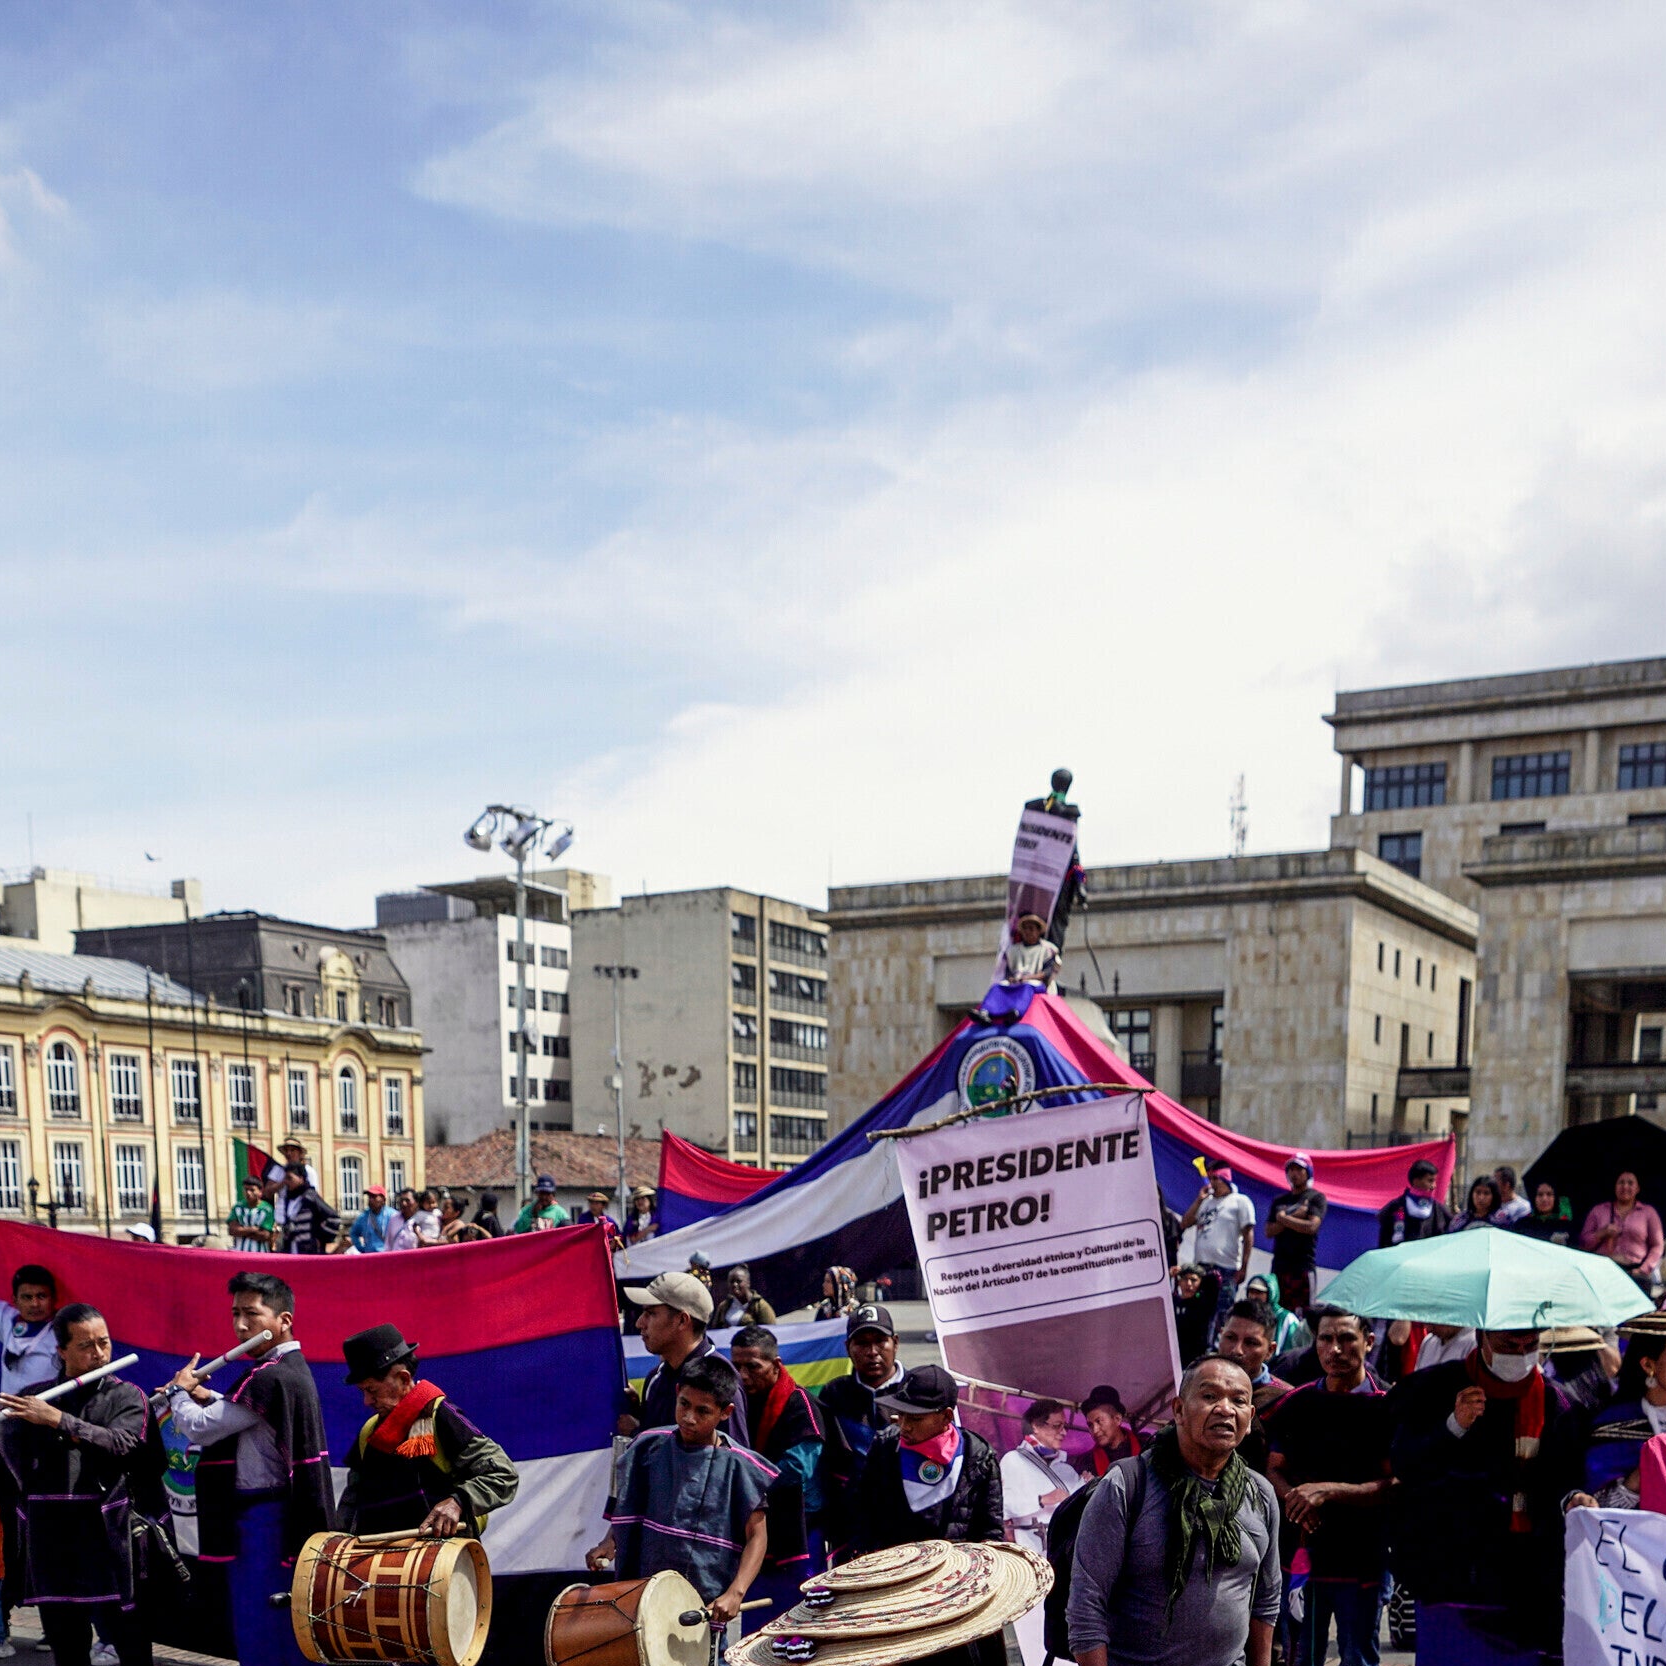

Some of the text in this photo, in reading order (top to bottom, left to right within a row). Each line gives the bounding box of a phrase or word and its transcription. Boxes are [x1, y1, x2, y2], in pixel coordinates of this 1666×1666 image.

[918, 1129, 1141, 1200] ¡PRESIDENTE
[927, 1193, 1051, 1242] PETRO!
[933, 1284, 964, 1296] Nación
[965, 1281, 980, 1292] del
[1022, 1271, 1034, 1281] 07
[1036, 1269, 1048, 1278] de
[1050, 1267, 1059, 1276] la
[1061, 1256, 1121, 1274] constitución
[1122, 1253, 1134, 1262] de
[940, 1267, 980, 1281] Respete
[981, 1266, 990, 1275] la
[992, 1256, 1043, 1272] diversidad
[1077, 1249, 1084, 1259] y
[1084, 1241, 1121, 1255] Cultural
[1123, 1239, 1135, 1248] de
[1136, 1237, 1145, 1246] la
[1595, 1519, 1642, 1574] EL
